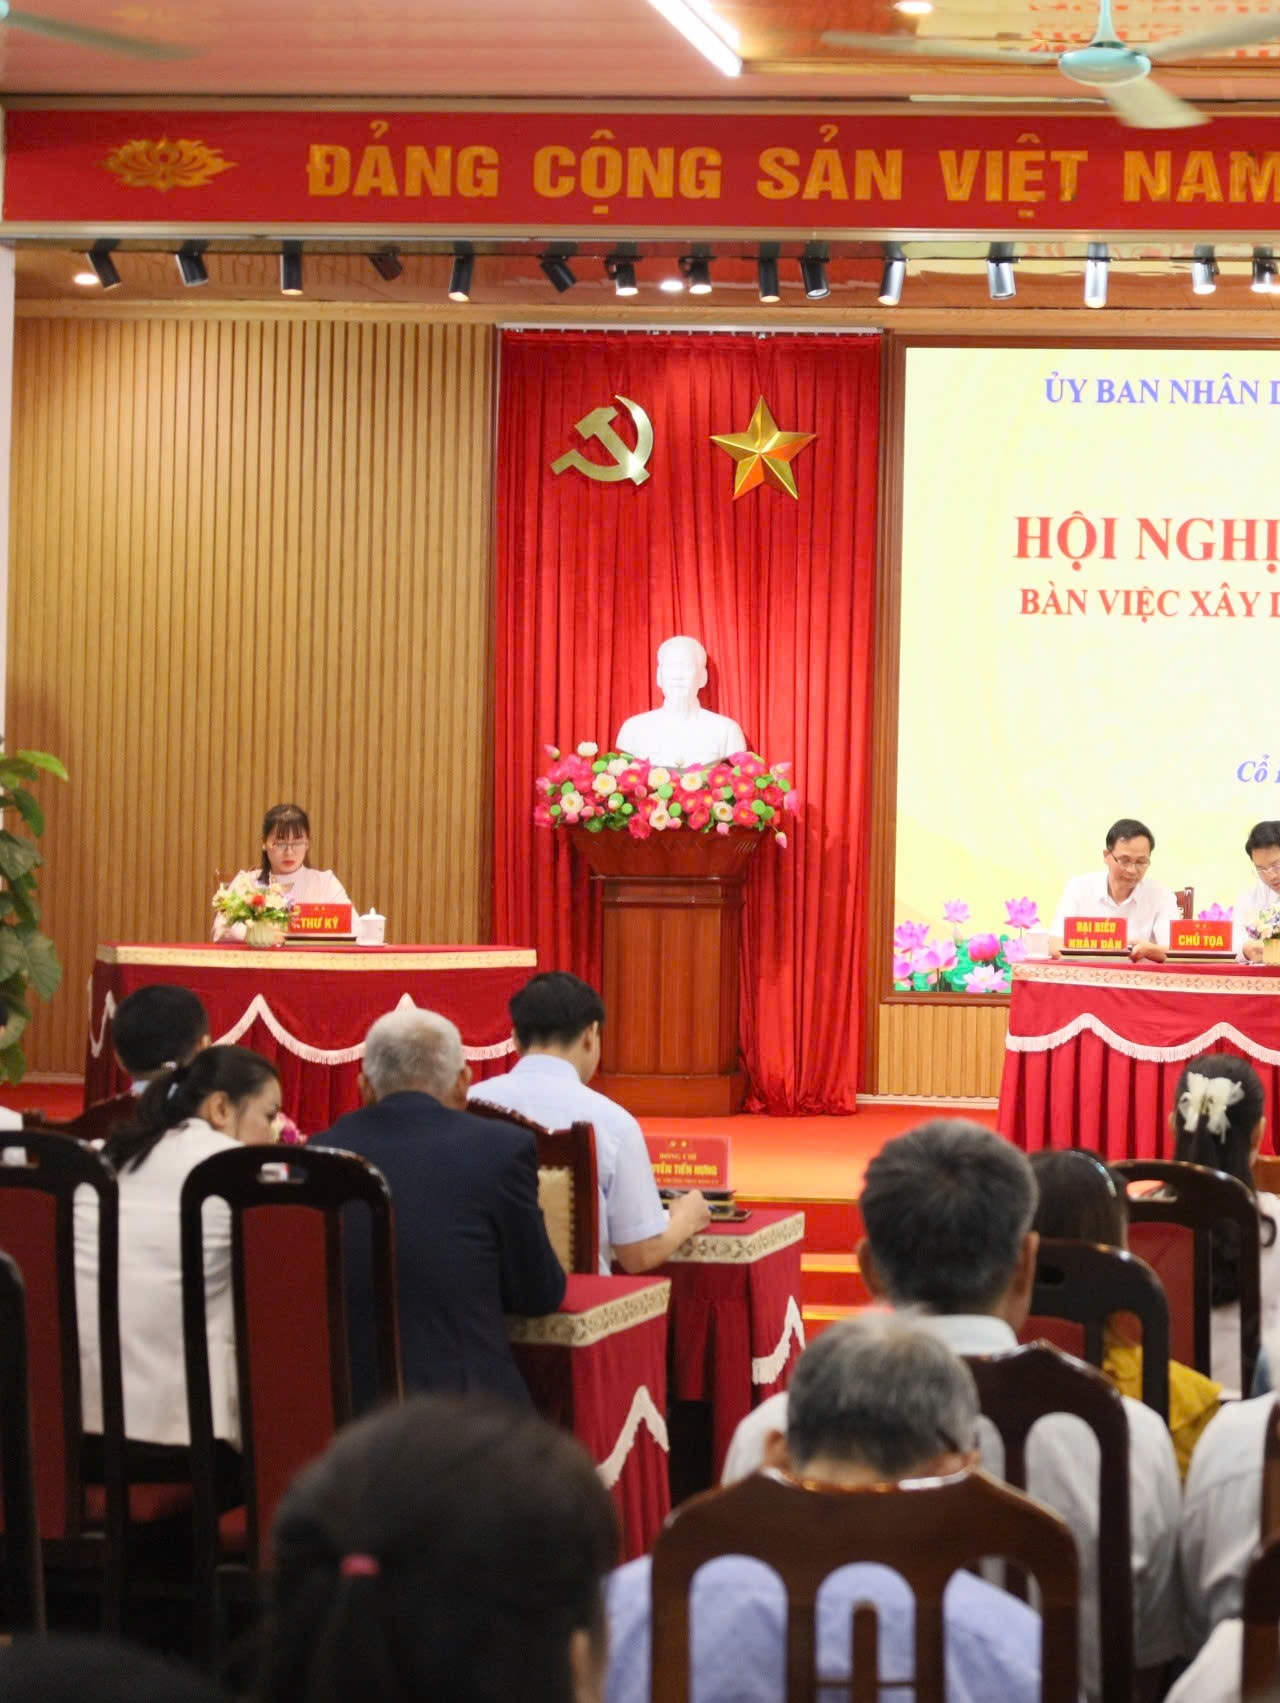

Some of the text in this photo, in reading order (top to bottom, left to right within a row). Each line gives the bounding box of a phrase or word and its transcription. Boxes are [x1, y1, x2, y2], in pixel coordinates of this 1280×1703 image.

[306, 120, 499, 198] ĐẢNG
[533, 130, 722, 214] CỘNG
[756, 125, 904, 202] SẢN
[939, 133, 1088, 218] VIỆT
[1044, 371, 1088, 404] ỦY
[1095, 378, 1160, 404] BAN
[1169, 373, 1260, 405] NHÂN
[1013, 510, 1117, 571] HỘI
[1136, 517, 1280, 574] NGHỊ
[1019, 580, 1088, 616] BÀN
[1097, 585, 1181, 623] VIỆC
[1188, 581, 1261, 618] XÂY
[1236, 754, 1270, 784] Cổ
[301, 915, 339, 929] THƯ KÝ
[1178, 933, 1224, 949] CHỦ TỌA
